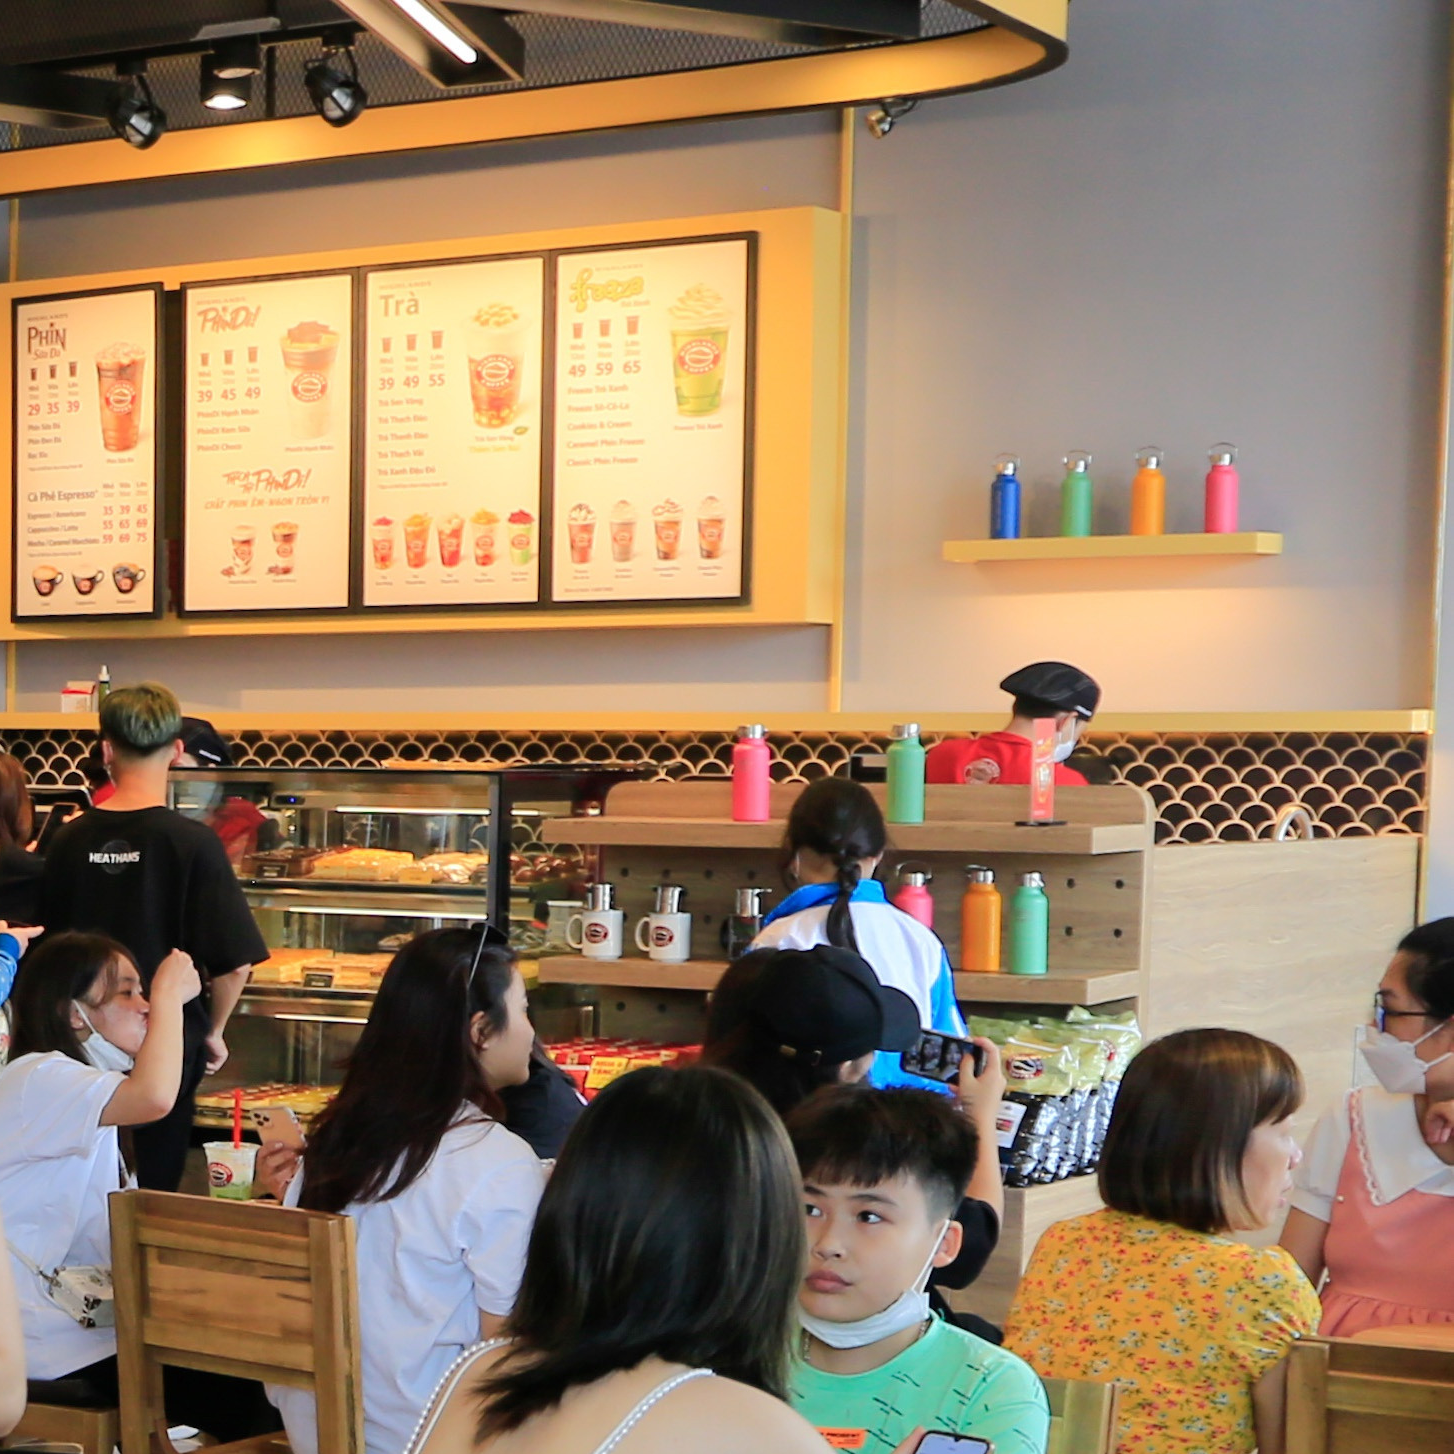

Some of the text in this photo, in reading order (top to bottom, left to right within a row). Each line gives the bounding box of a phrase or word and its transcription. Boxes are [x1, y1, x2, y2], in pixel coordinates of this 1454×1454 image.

[379, 291, 420, 318] Trà
[568, 360, 642, 378] 49 59 65
[378, 373, 445, 391] 39 49 55
[196, 386, 261, 403] 39 45 49
[28, 400, 80, 416] 29 35 39
[103, 506, 113, 516] 35
[119, 504, 131, 515] 39
[136, 504, 147, 514] 45
[103, 520, 113, 530] 55
[119, 519, 131, 529] 65
[103, 533, 113, 544] 59
[136, 532, 147, 543] 75
